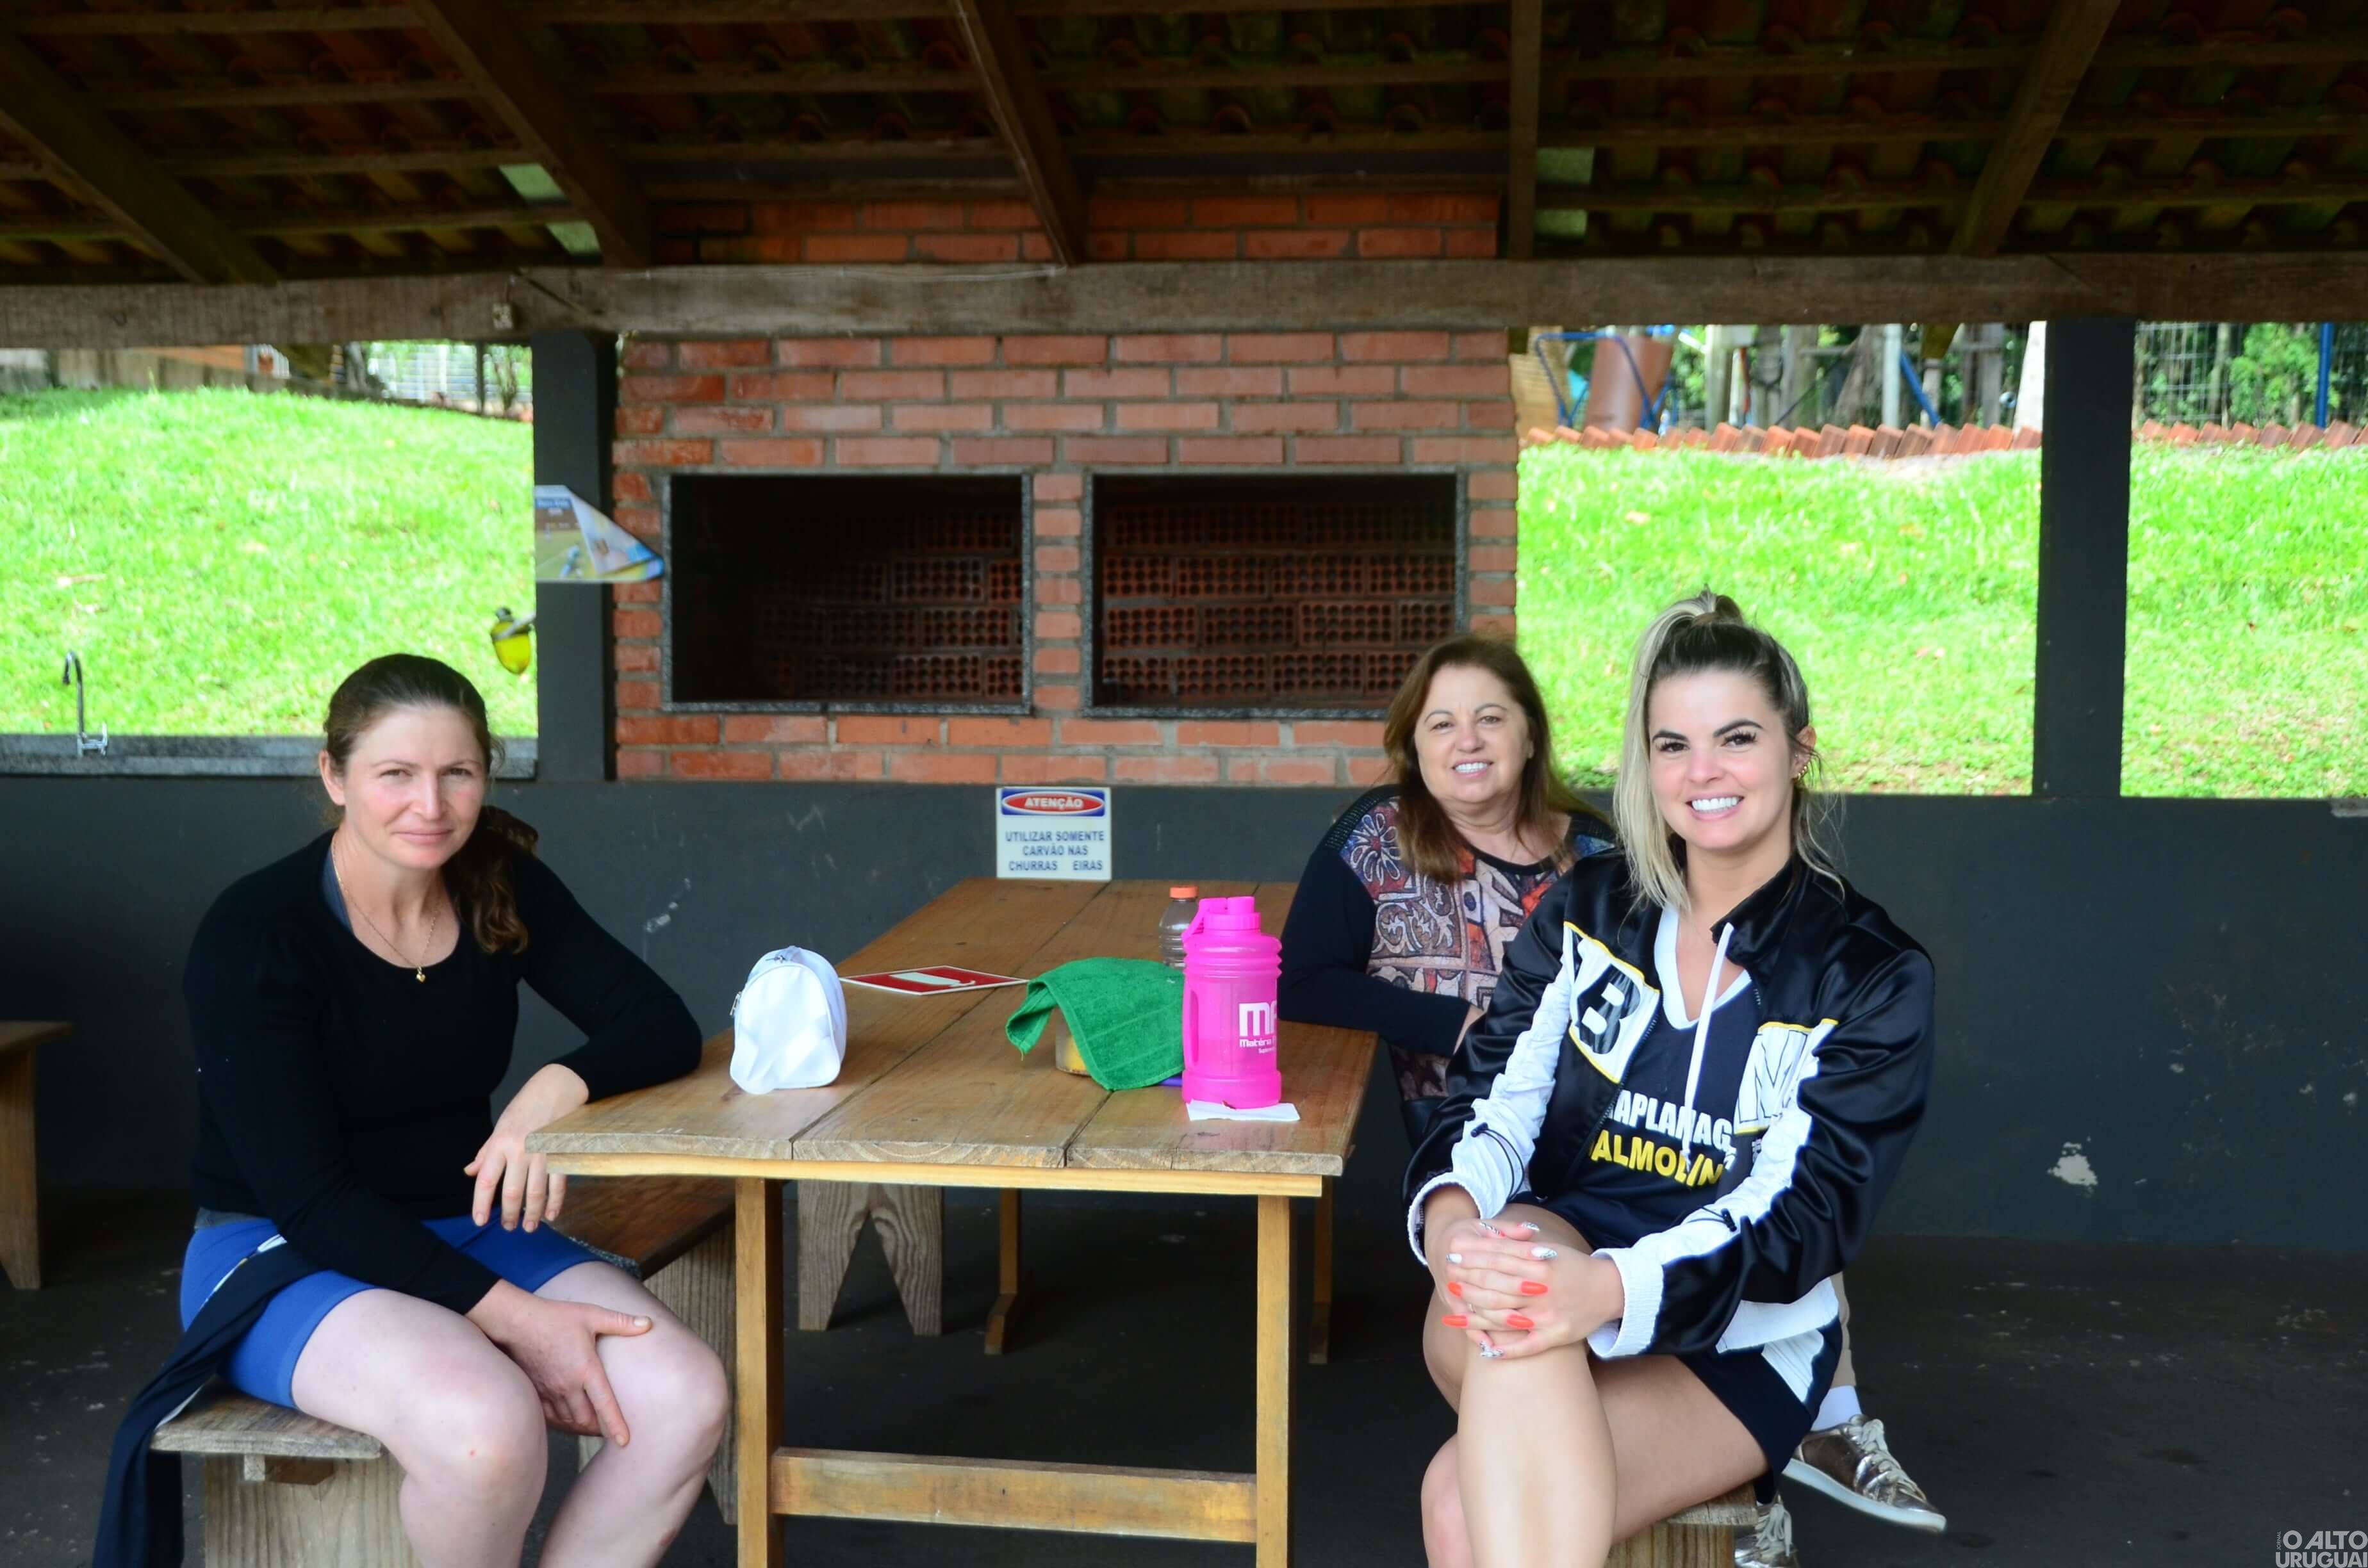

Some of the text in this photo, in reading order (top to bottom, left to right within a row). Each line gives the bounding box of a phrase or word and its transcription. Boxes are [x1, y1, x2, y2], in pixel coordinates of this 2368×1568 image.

[1024, 797, 1083, 810] ATENÇÃO
[1006, 831, 1104, 842] UTILIZAR SOMENTE
[1023, 844, 1088, 856] CARVÃO NAS
[1009, 860, 1103, 871] CHURRAS EIRAS
[1589, 1129, 1723, 1187] ALMOLIN
